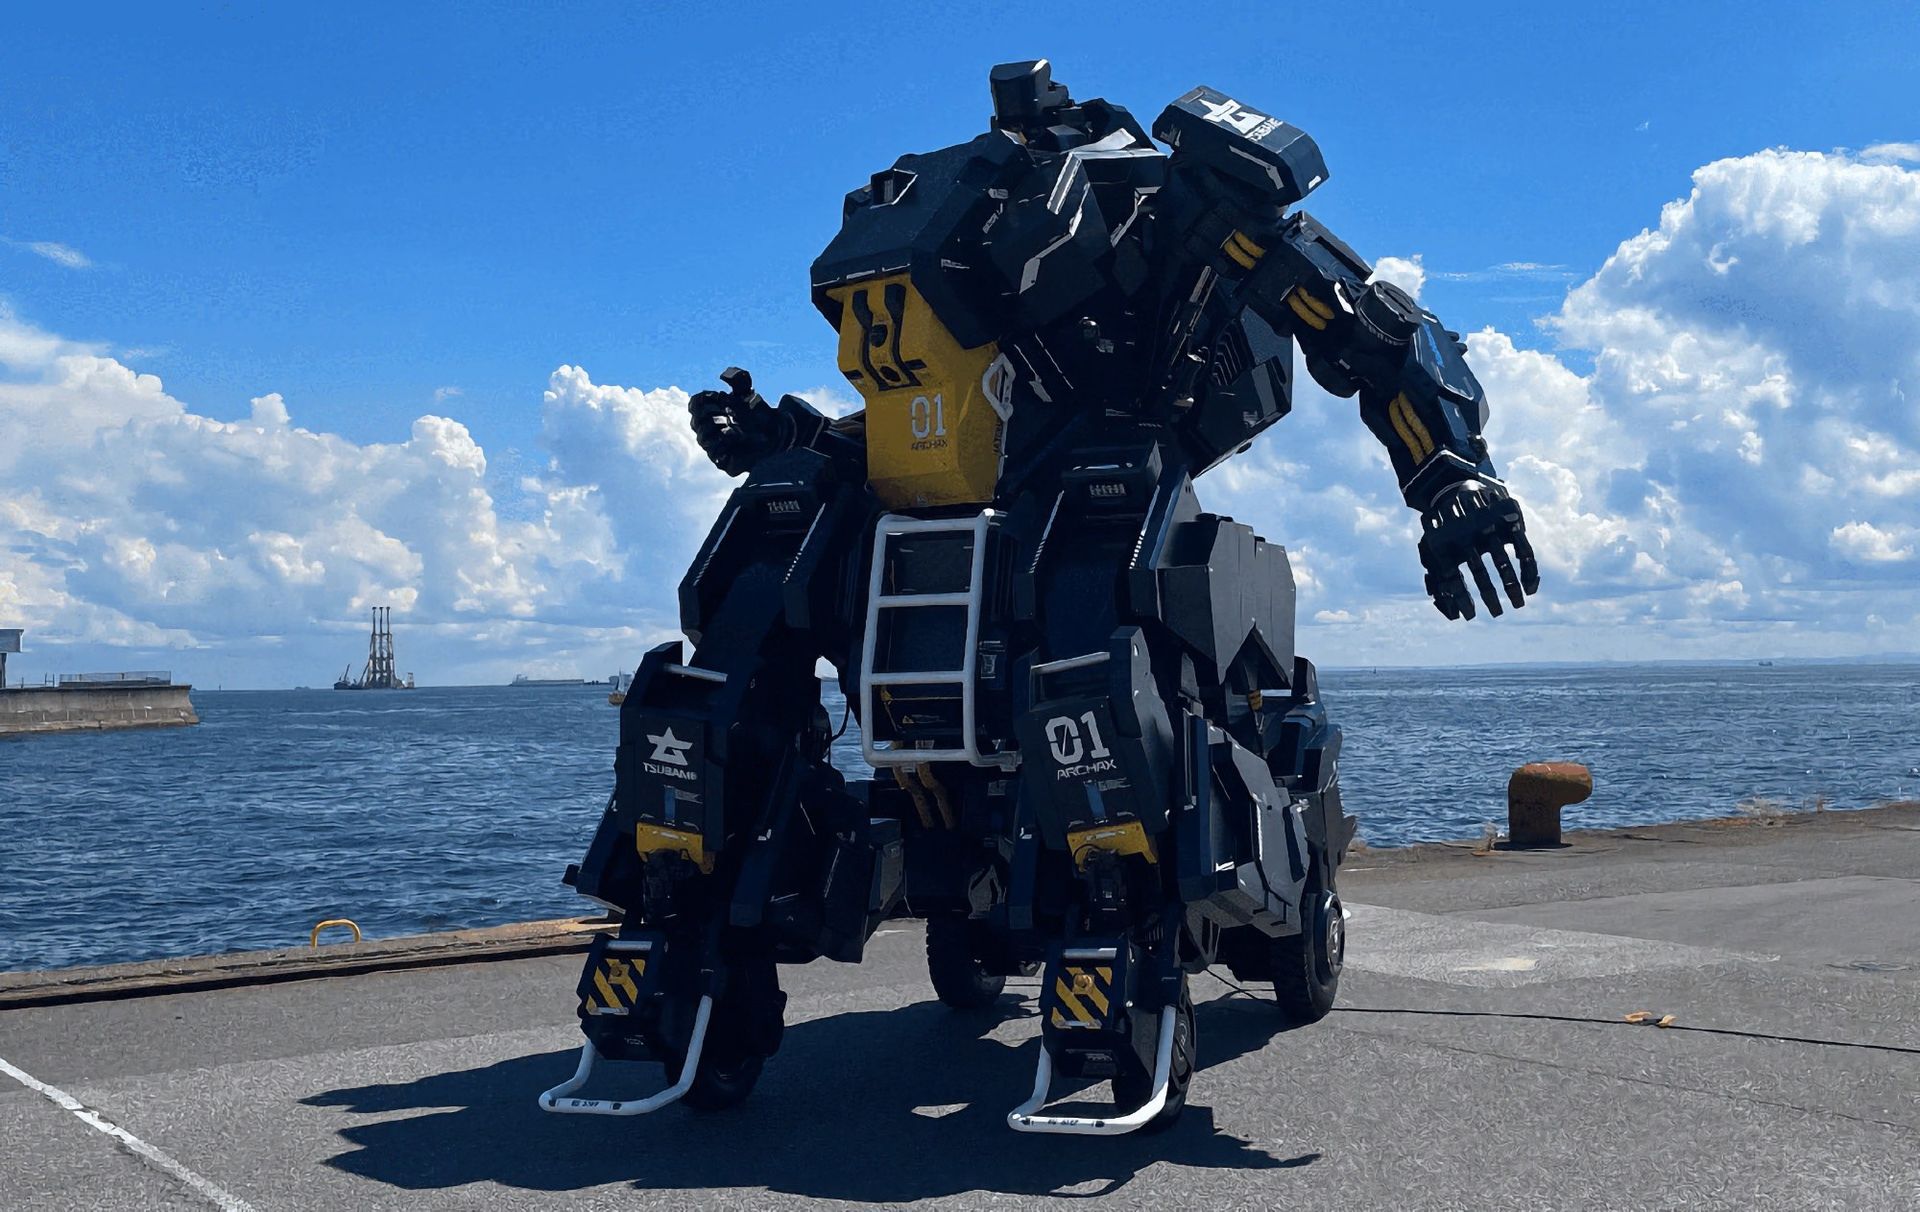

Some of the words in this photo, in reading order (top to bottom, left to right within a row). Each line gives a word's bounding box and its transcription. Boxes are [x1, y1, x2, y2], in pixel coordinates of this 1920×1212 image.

[911, 393, 946, 439] 01
[1044, 711, 1110, 765] 01
[1057, 759, 1117, 780] ARCHAX
